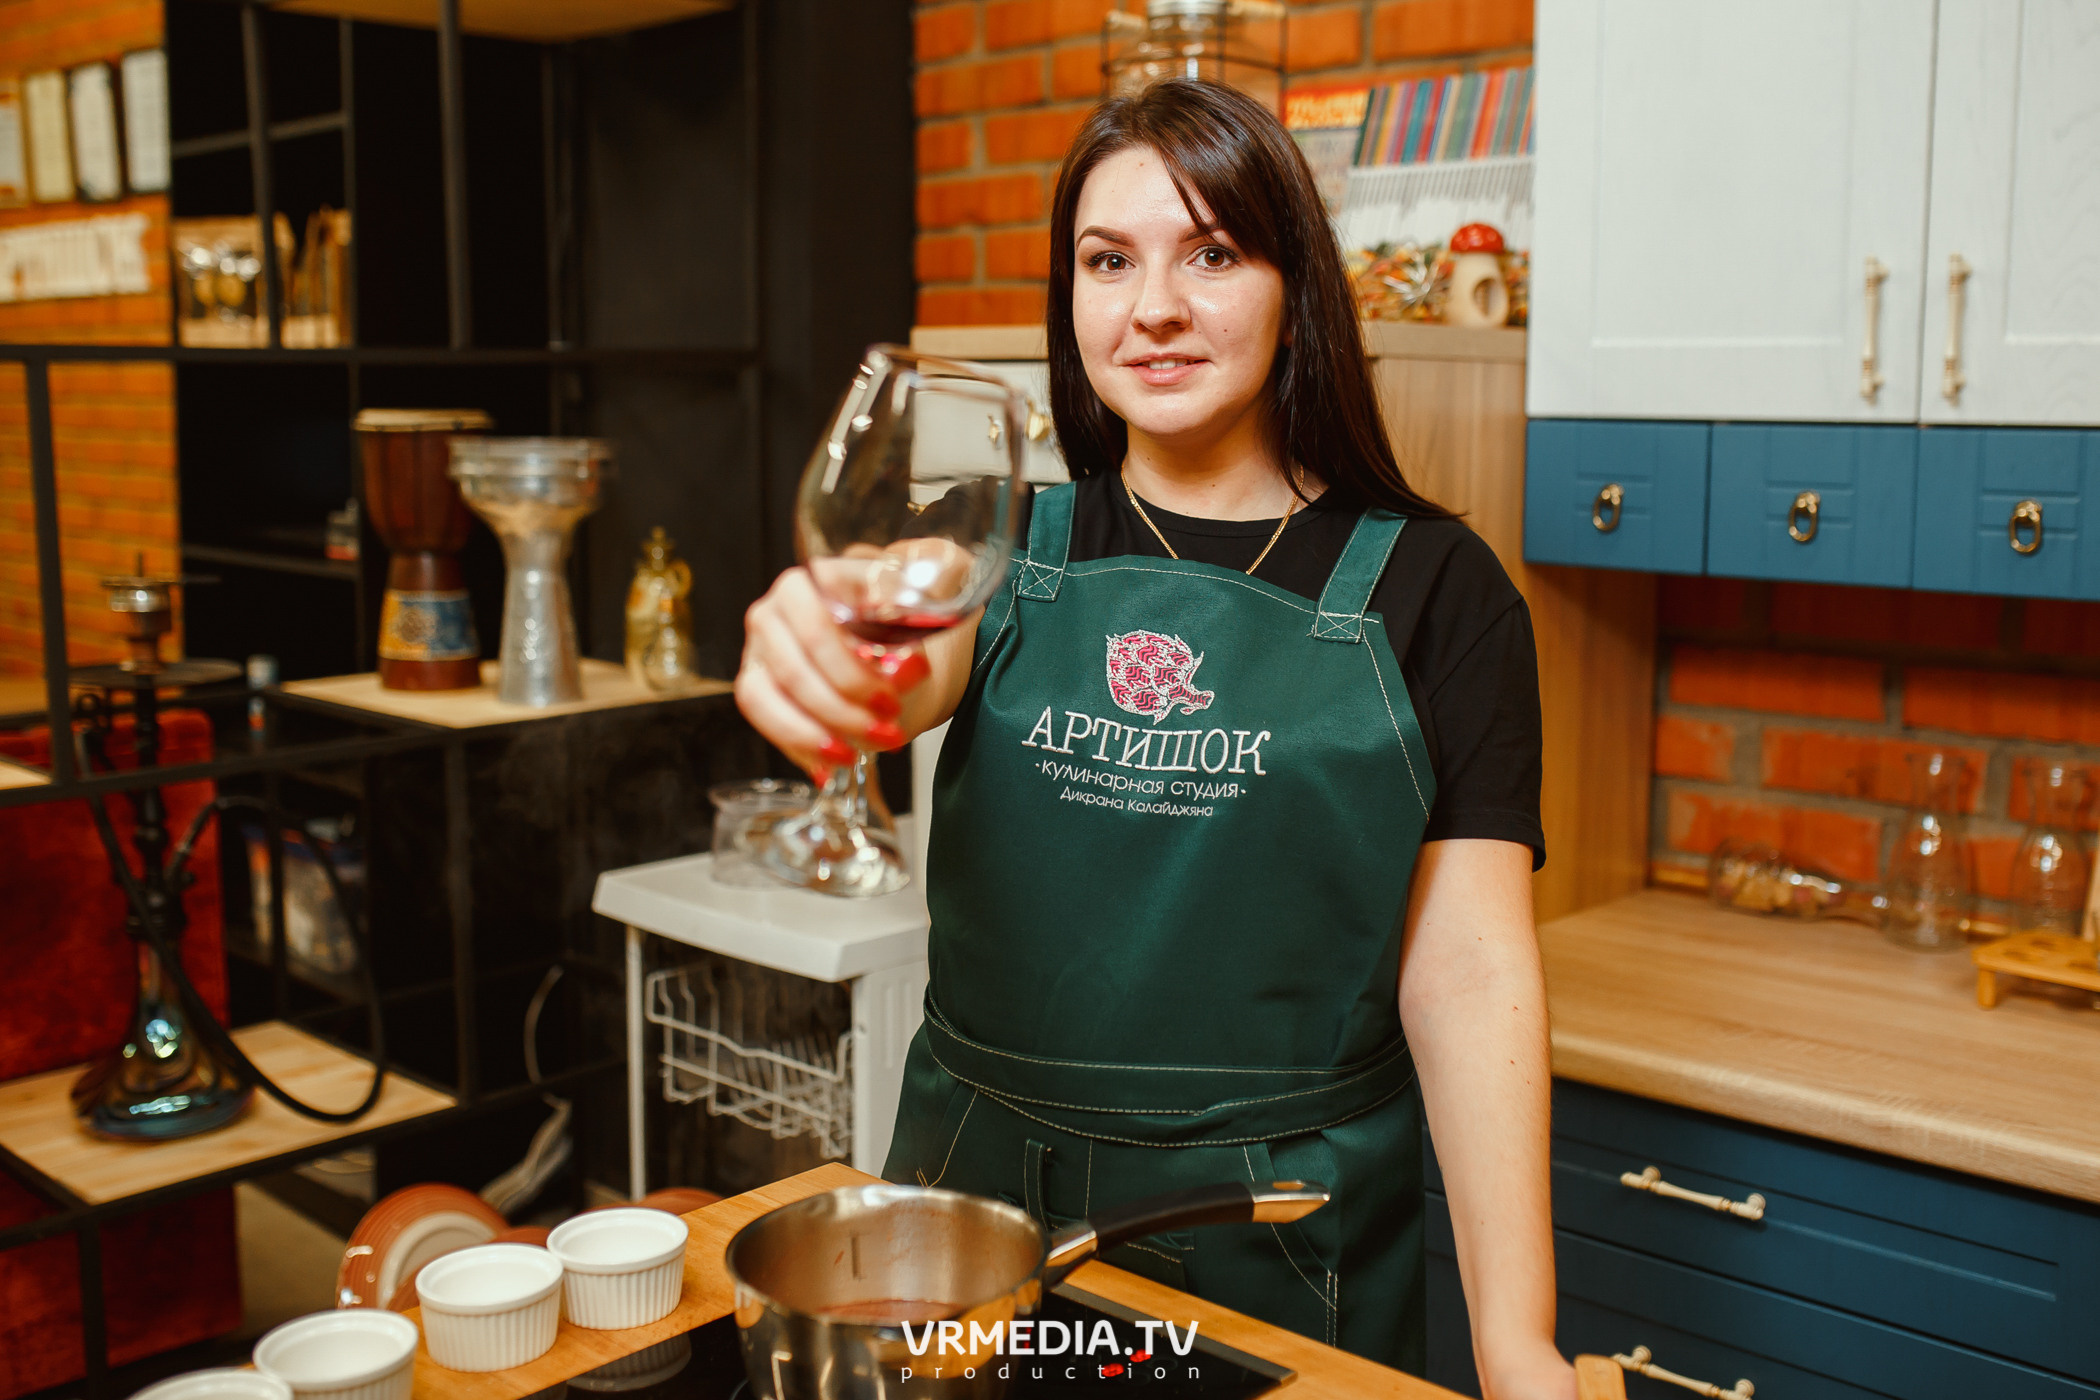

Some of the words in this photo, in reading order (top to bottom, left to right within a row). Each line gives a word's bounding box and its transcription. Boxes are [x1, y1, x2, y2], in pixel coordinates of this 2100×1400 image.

[1021, 705, 1271, 776] АРТИШОК
[1060, 786, 1124, 810] Дикрана
[1127, 798, 1214, 817] Калайджяна
